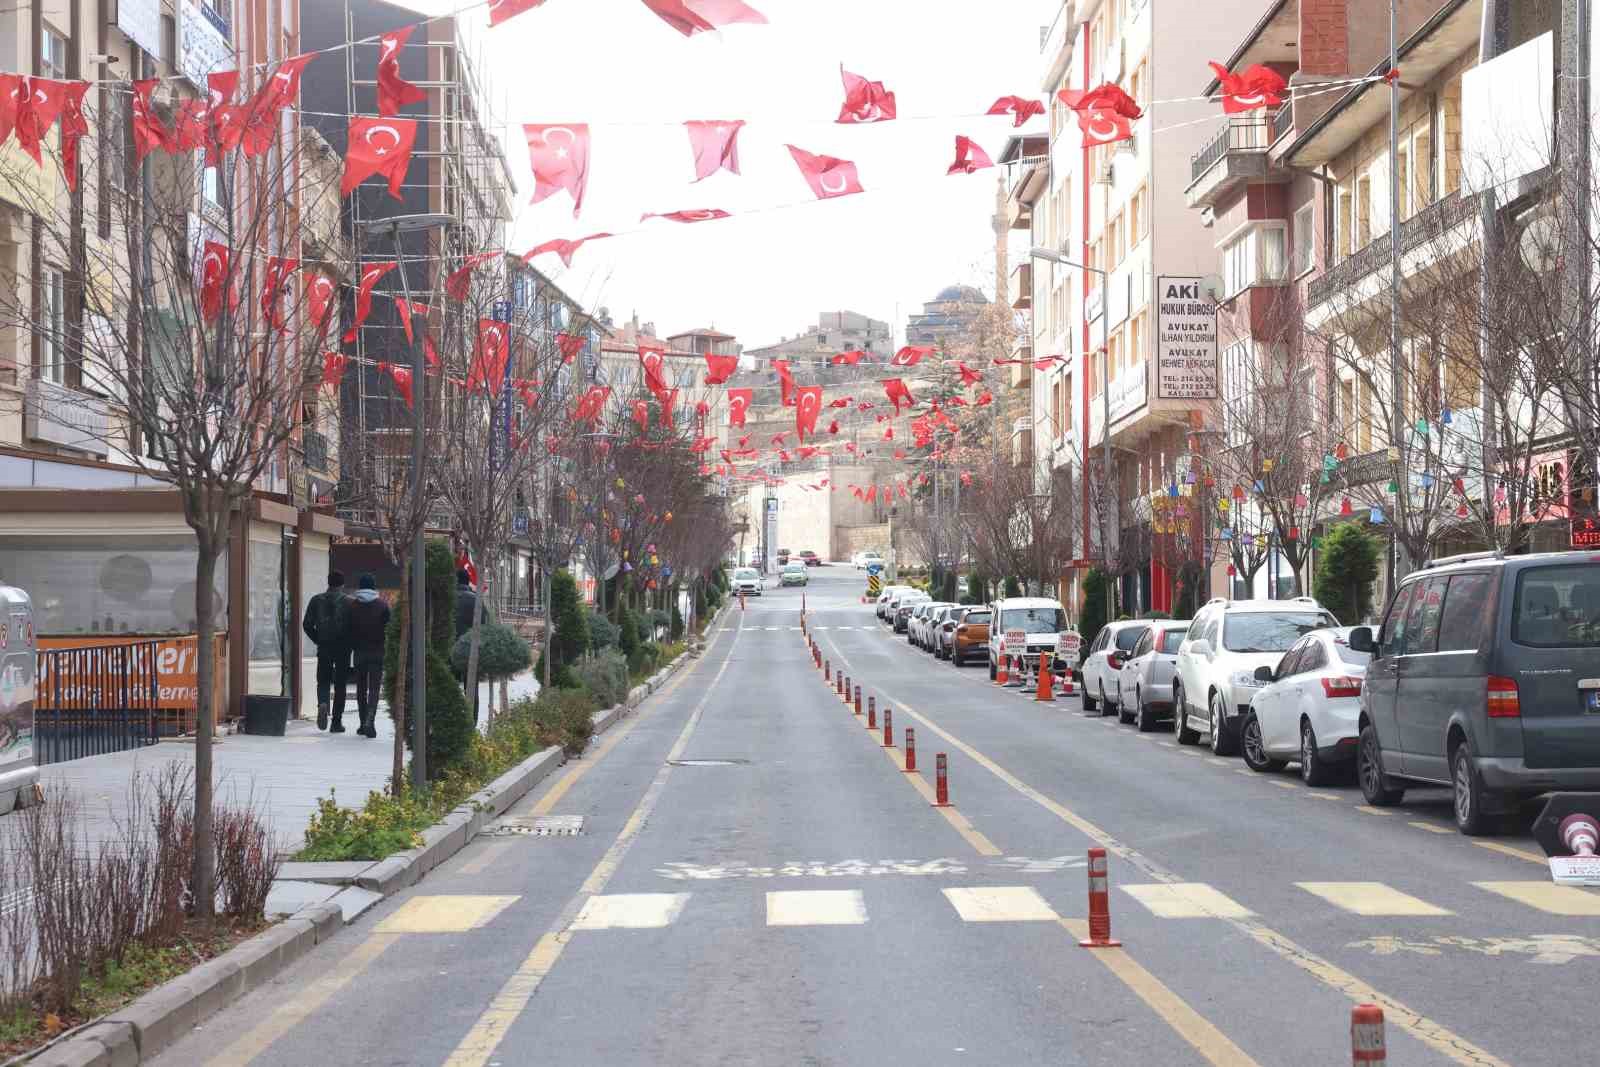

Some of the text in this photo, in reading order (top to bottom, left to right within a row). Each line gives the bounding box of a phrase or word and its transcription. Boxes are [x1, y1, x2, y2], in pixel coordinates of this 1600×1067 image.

[1161, 301, 1216, 316] HUKUK BÜROSU
[1167, 323, 1209, 331] AVUKAT
[1161, 331, 1215, 343] İLHAN YILDIRIM
[1168, 348, 1208, 357] AVUKAT
[1161, 358, 1184, 368] MEHMET
[1200, 359, 1216, 368] ACAR
